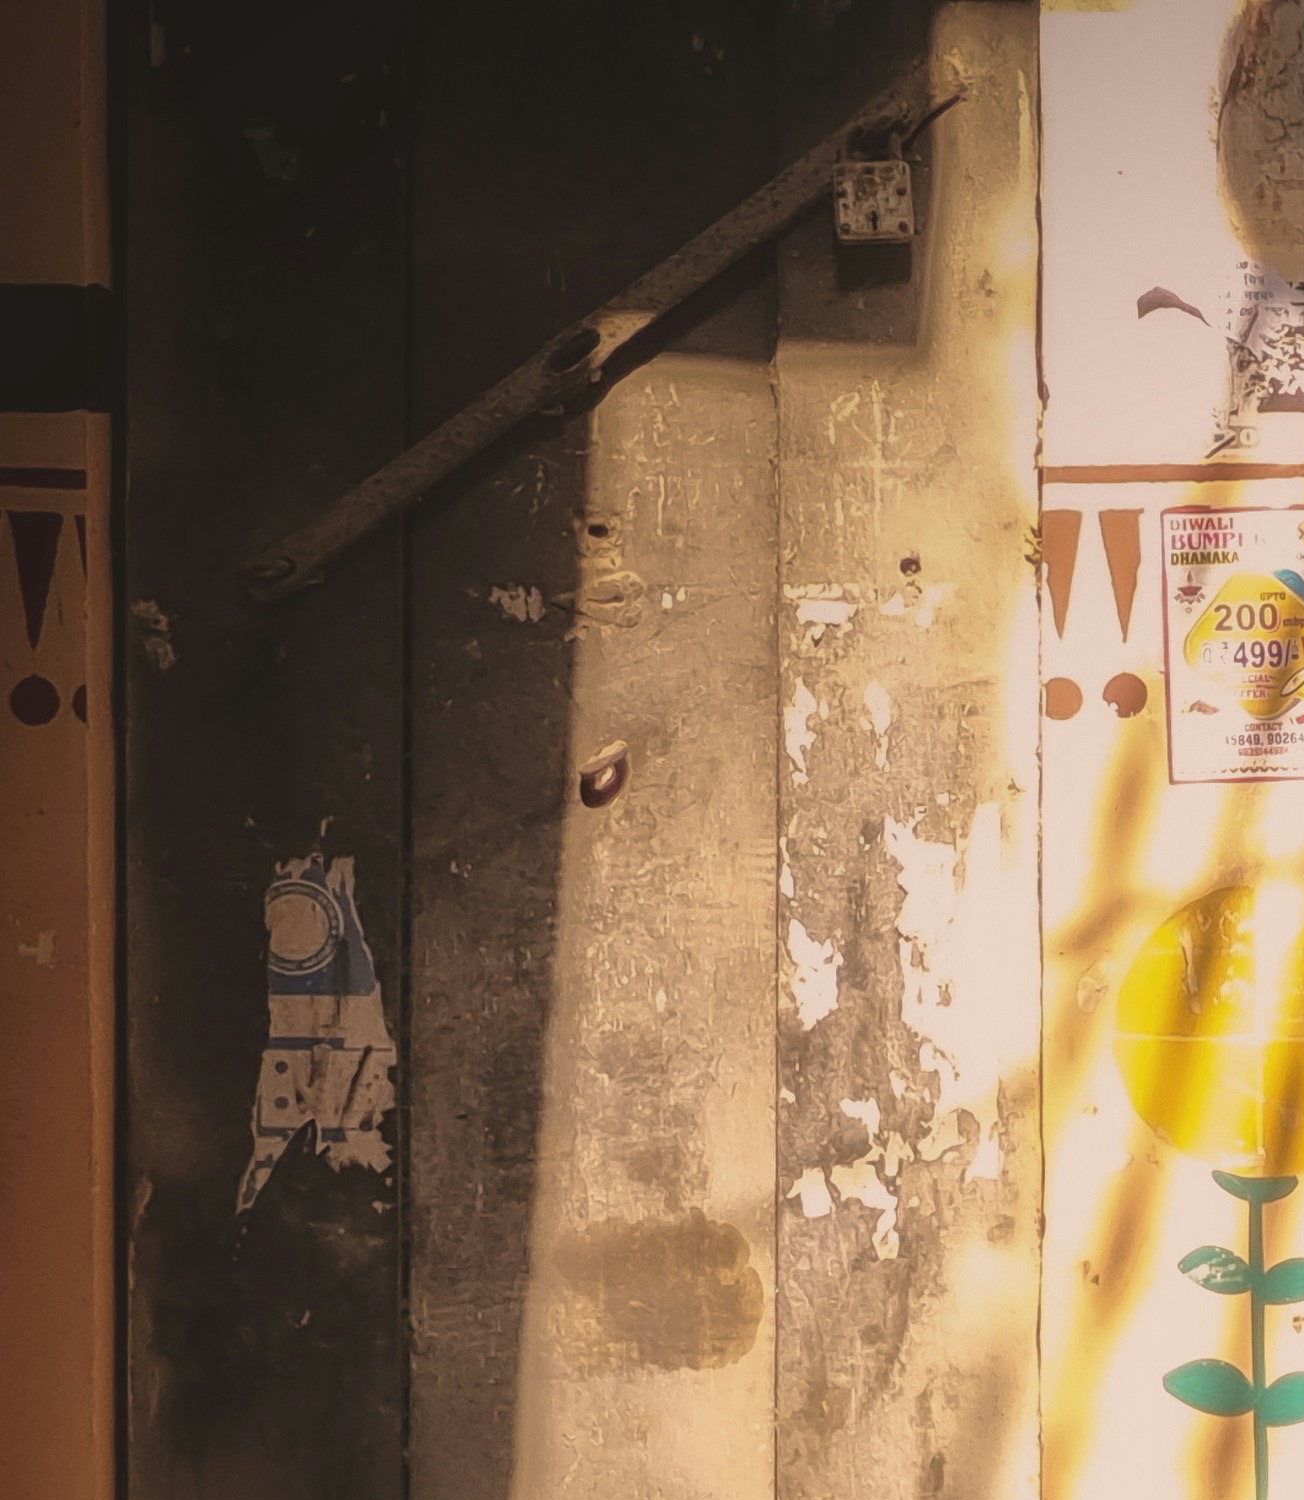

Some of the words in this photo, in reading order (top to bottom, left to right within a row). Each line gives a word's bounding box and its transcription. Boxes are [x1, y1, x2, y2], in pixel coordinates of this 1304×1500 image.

[1170, 517, 1234, 531] DIWALI
[1170, 551, 1240, 566] DHAMAKA
[1213, 603, 1280, 632] 200
